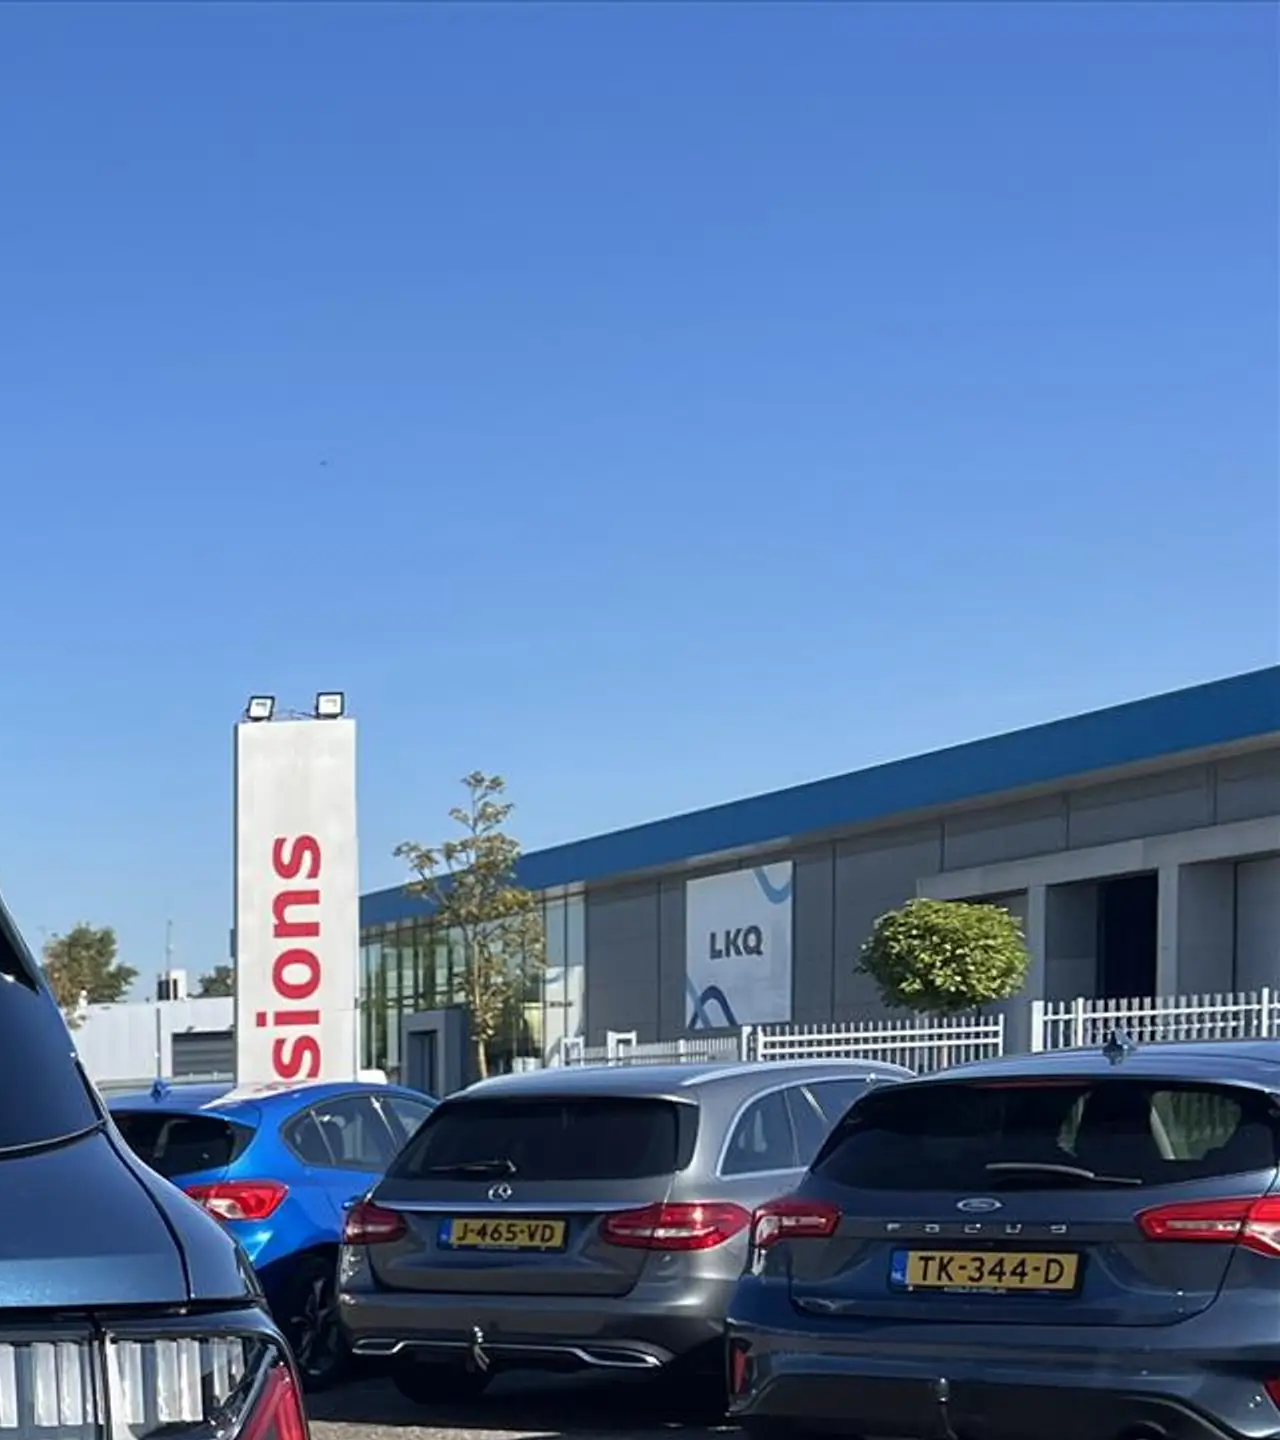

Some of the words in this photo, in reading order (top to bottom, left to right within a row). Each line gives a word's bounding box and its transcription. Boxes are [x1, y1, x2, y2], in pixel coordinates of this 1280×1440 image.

[255, 834, 321, 1080] sions
[709, 925, 764, 960] LKQ
[455, 1222, 556, 1243] J-465-VD
[917, 1255, 1065, 1285] TK-344-D
